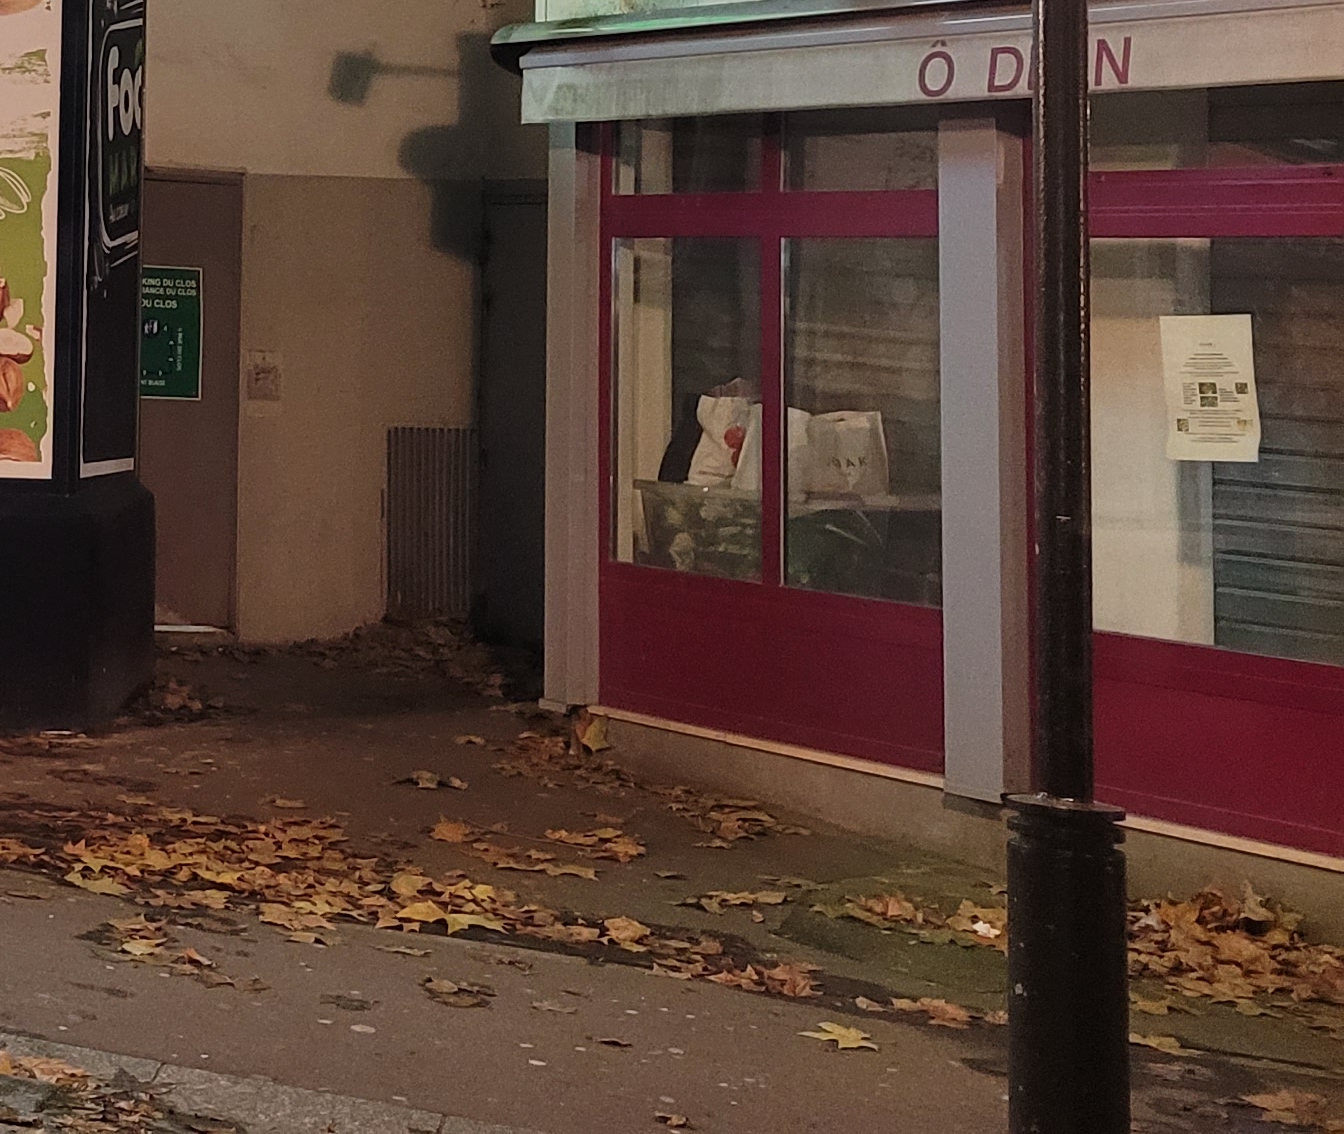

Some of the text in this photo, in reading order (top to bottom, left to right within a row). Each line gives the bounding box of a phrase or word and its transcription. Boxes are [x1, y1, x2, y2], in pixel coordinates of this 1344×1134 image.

[918, 39, 955, 97] Ô
[142, 278, 196, 288] KING DU CLOS
[154, 299, 178, 308] CLOS
